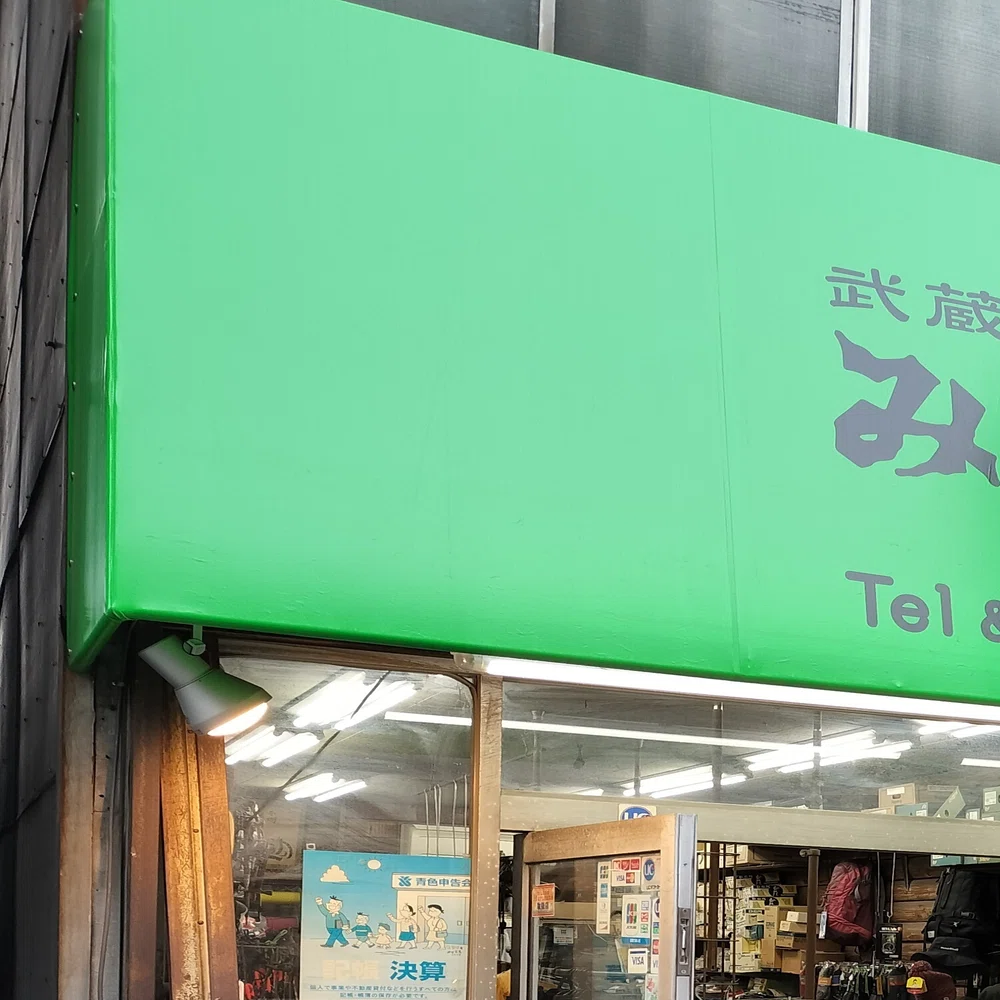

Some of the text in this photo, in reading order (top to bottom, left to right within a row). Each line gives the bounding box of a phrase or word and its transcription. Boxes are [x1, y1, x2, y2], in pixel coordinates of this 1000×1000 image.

[845, 571, 952, 637] Tel
[416, 876, 470, 887] 青色申告会
[632, 956, 645, 966] VISA
[390, 960, 447, 981] 決算
